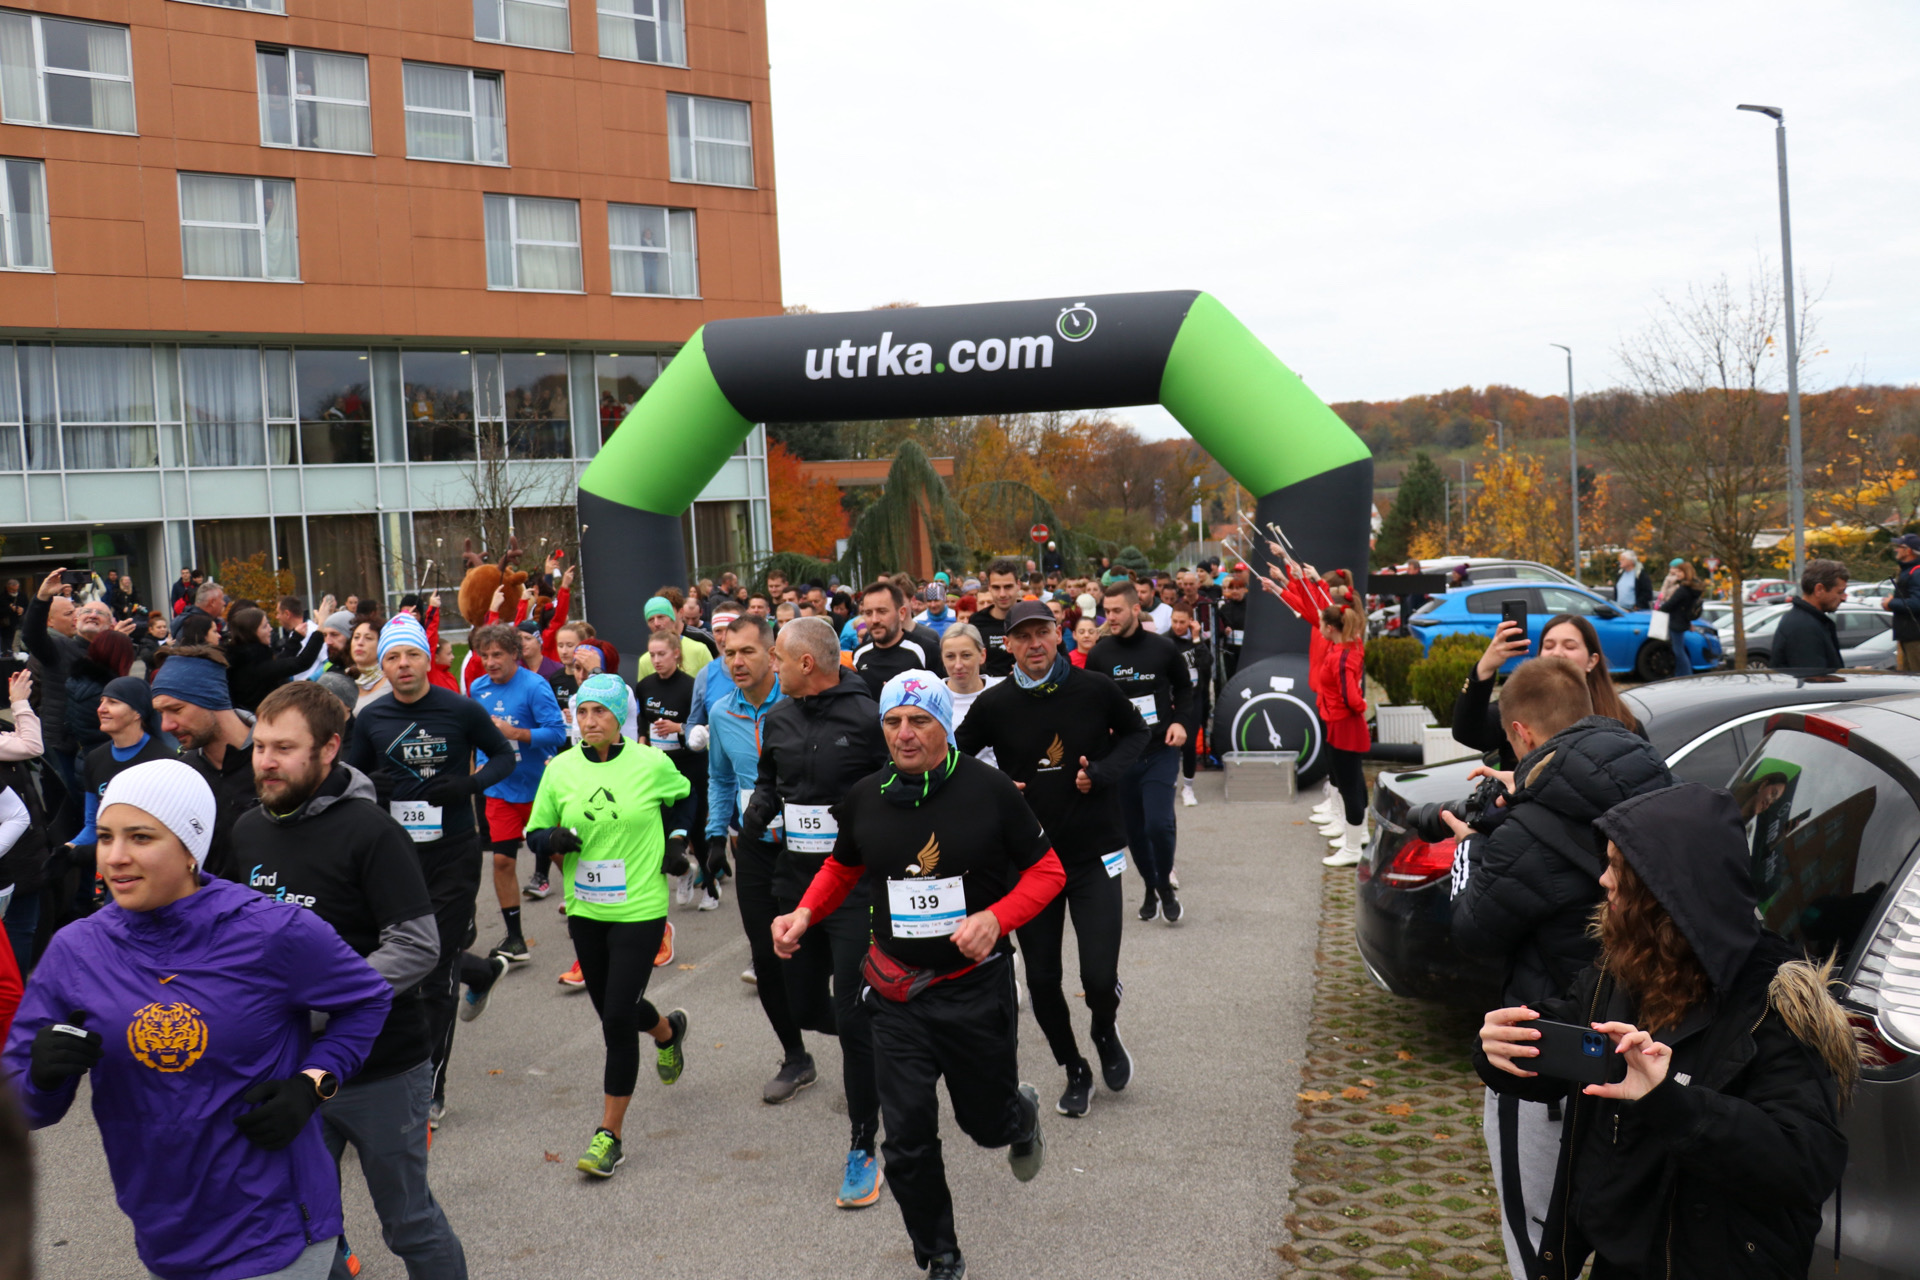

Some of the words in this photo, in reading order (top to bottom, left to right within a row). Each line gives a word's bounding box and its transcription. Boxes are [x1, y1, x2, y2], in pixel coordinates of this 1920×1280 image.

[805, 331, 1054, 380] utrka.com
[403, 811, 425, 821] 238
[798, 817, 821, 829] 155
[249, 864, 278, 887] Fund
[586, 872, 602, 883] 91
[909, 894, 939, 910] 139
